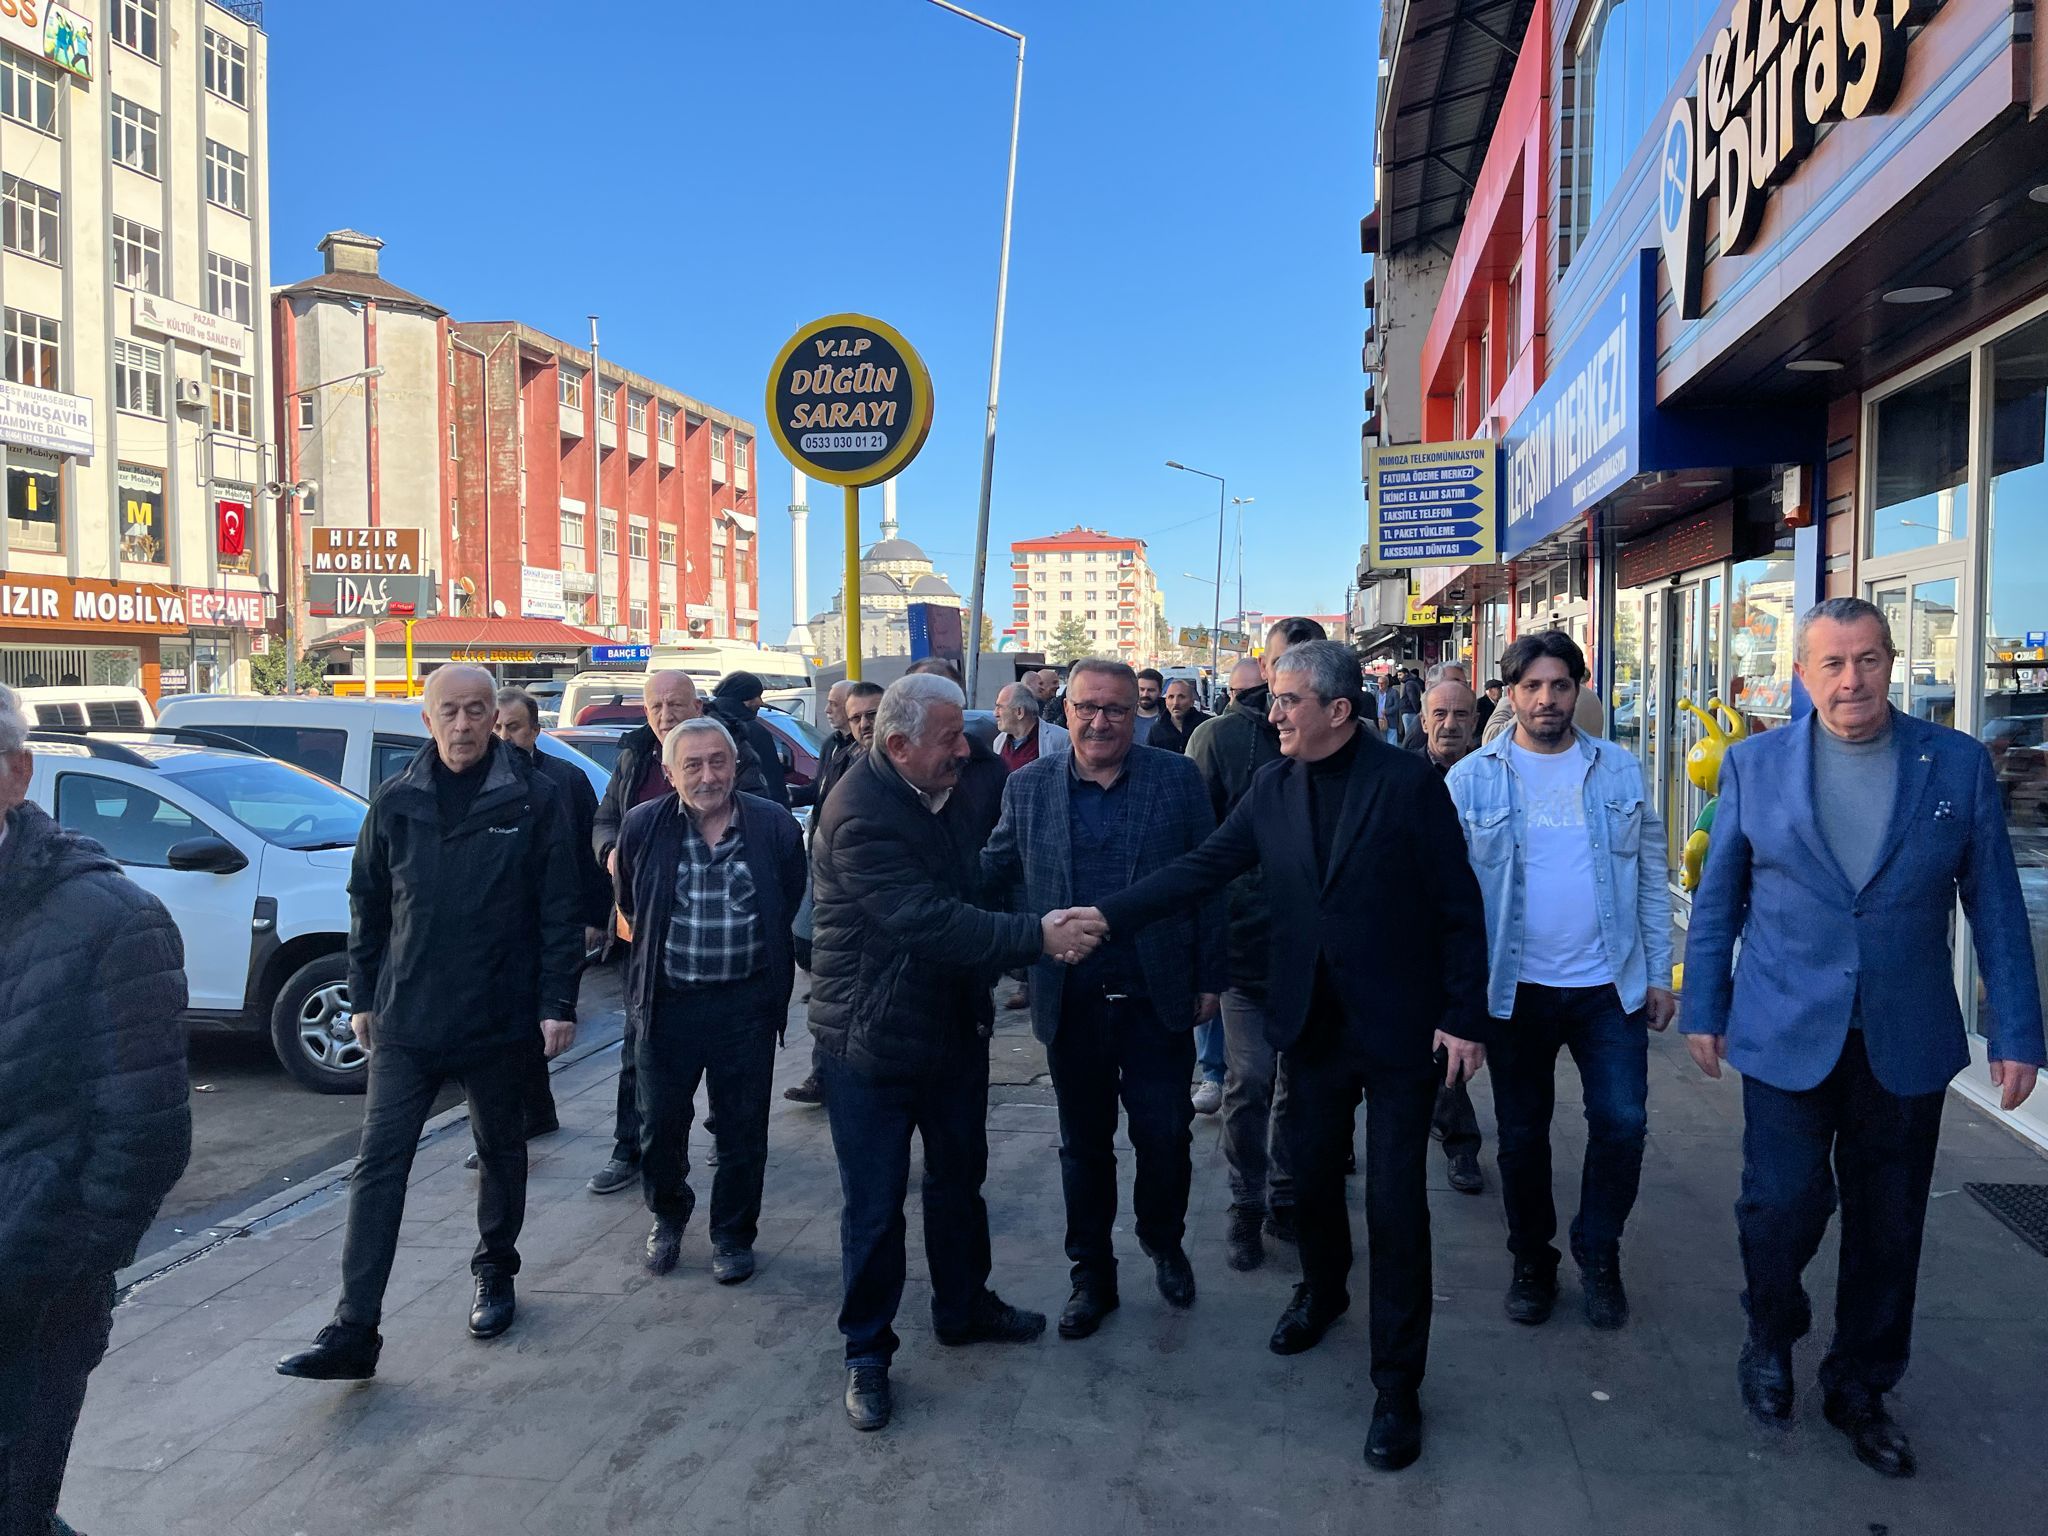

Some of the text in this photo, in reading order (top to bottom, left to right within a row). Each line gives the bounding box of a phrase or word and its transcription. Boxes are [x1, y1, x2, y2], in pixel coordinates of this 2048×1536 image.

[193, 312, 216, 328] PAZAR
[166, 317, 196, 337] KÜLTÜR
[206, 331, 229, 347] SANAT
[816, 338, 872, 357] V.I.P
[790, 362, 898, 395] DÜĞÜN
[1555, 293, 1627, 488] MERKEZİ
[790, 401, 897, 429] SARAYI
[47, 424, 67, 437] BAL
[805, 435, 884, 449] 0533 030 01 21
[1382, 472, 1412, 484] FATURA
[1412, 469, 1440, 482] ÖDEME
[1408, 491, 1419, 501] EL
[1420, 489, 1440, 501] ALIM
[1440, 488, 1466, 499] SATIM
[127, 500, 152, 525] M
[1383, 508, 1453, 522] TAKSİTLE TELEFON
[330, 529, 398, 547] HIZIR
[1383, 525, 1456, 539] TL PAKET YÜKLEME
[1383, 543, 1460, 558] AKSESUAR DÜNYASI
[315, 550, 412, 570] MOBİLYA
[74, 587, 185, 624] MOBİLYA
[190, 594, 260, 622] ECZANE
[254, 640, 263, 651] E
[607, 648, 637, 660] BAHÇE
